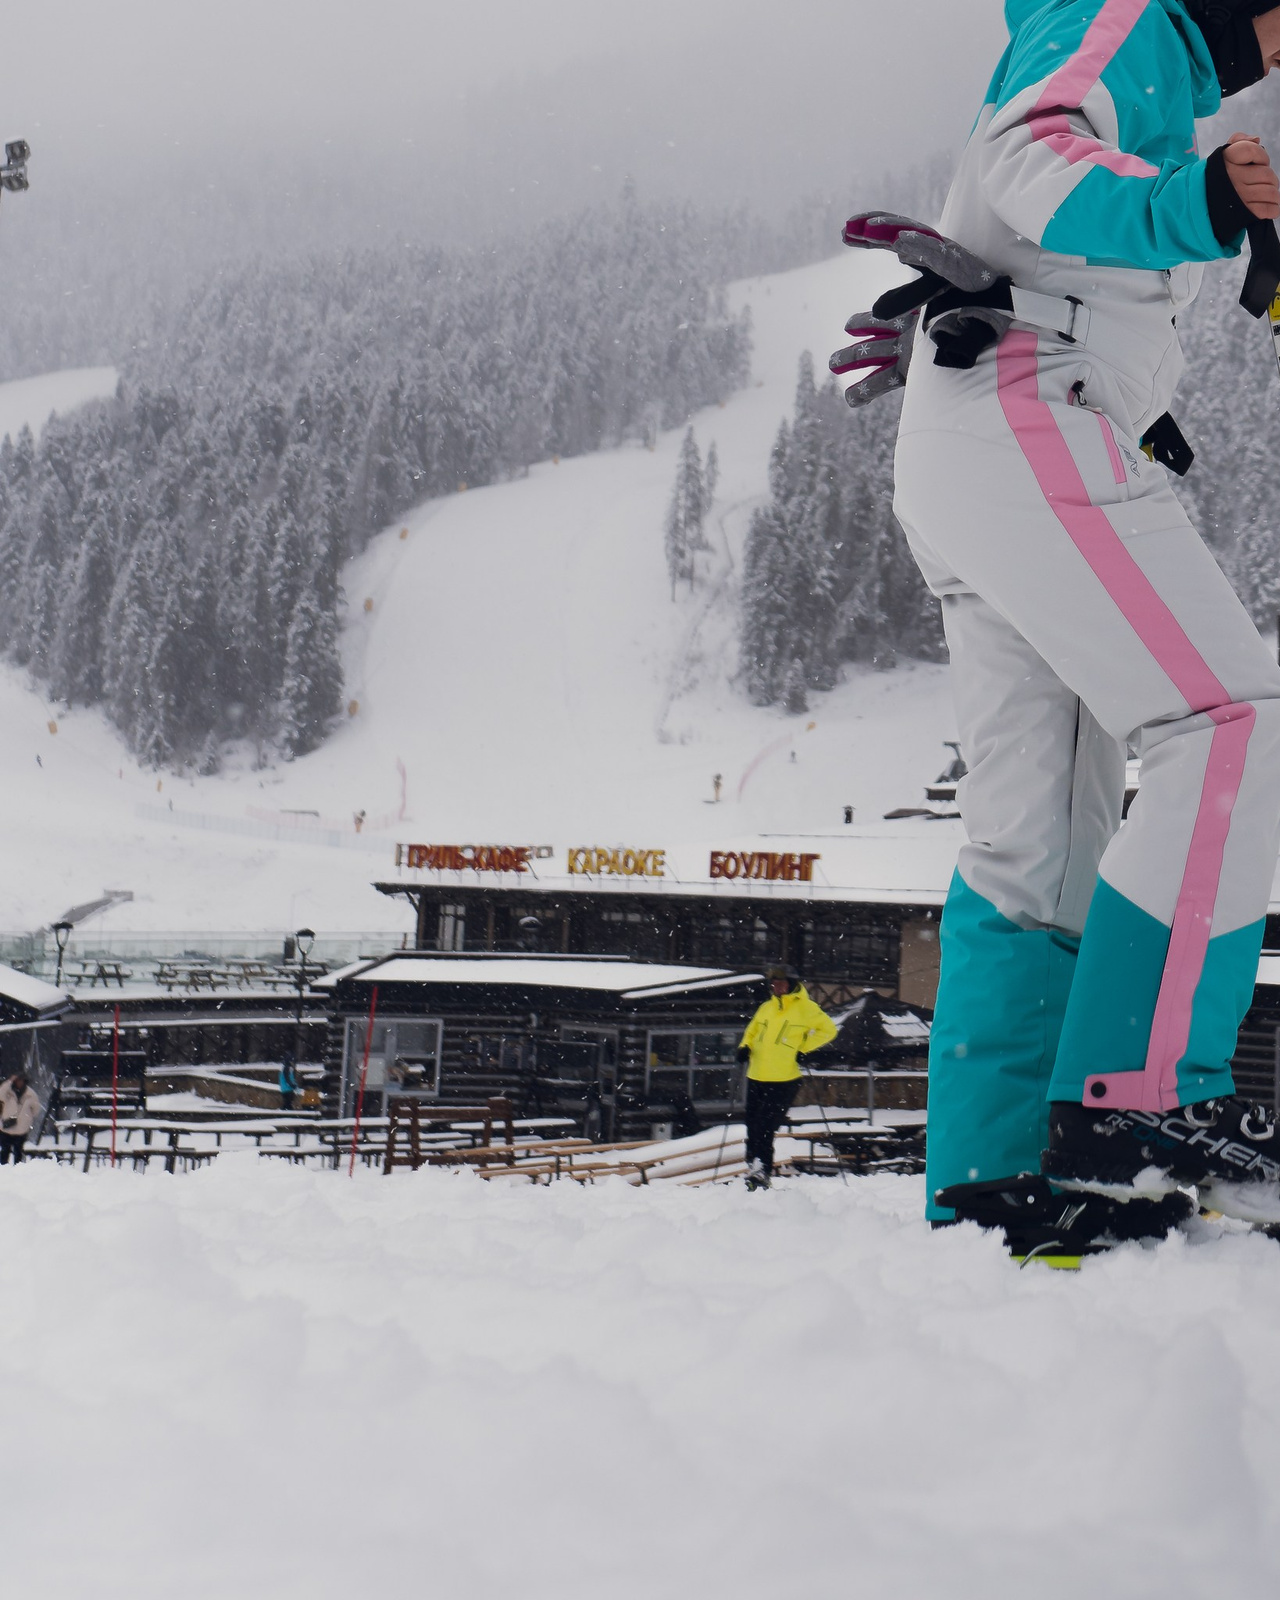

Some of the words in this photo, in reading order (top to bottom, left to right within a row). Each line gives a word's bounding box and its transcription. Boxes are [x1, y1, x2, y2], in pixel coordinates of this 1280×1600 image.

[567, 848, 666, 877] КАРАОКЕ
[709, 850, 821, 882] БОУЛИНГ
[1105, 1113, 1134, 1131] RC
[1132, 1123, 1180, 1150] ONE
